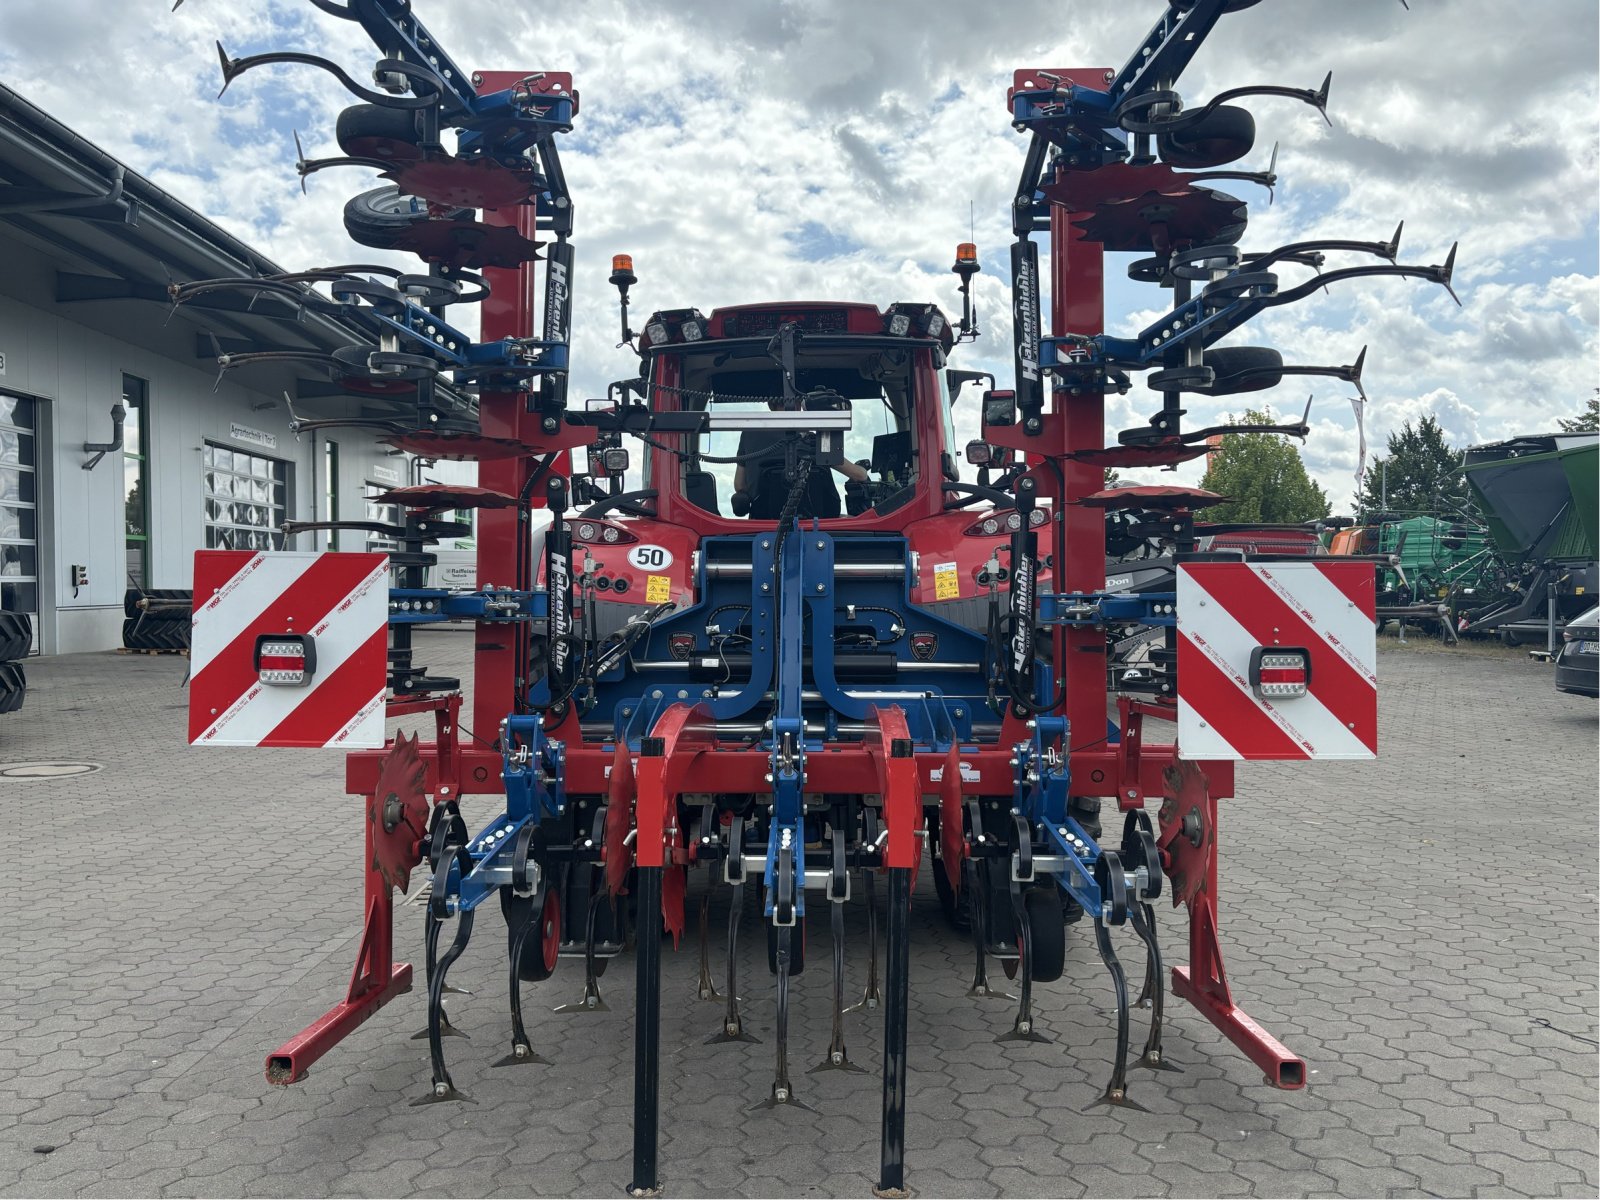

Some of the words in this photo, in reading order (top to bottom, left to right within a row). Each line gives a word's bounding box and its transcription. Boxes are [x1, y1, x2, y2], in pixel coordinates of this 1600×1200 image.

[1016, 256, 1038, 382] Hatzenbichler
[551, 552, 568, 674] Hatzenbihler
[636, 548, 664, 566] 50
